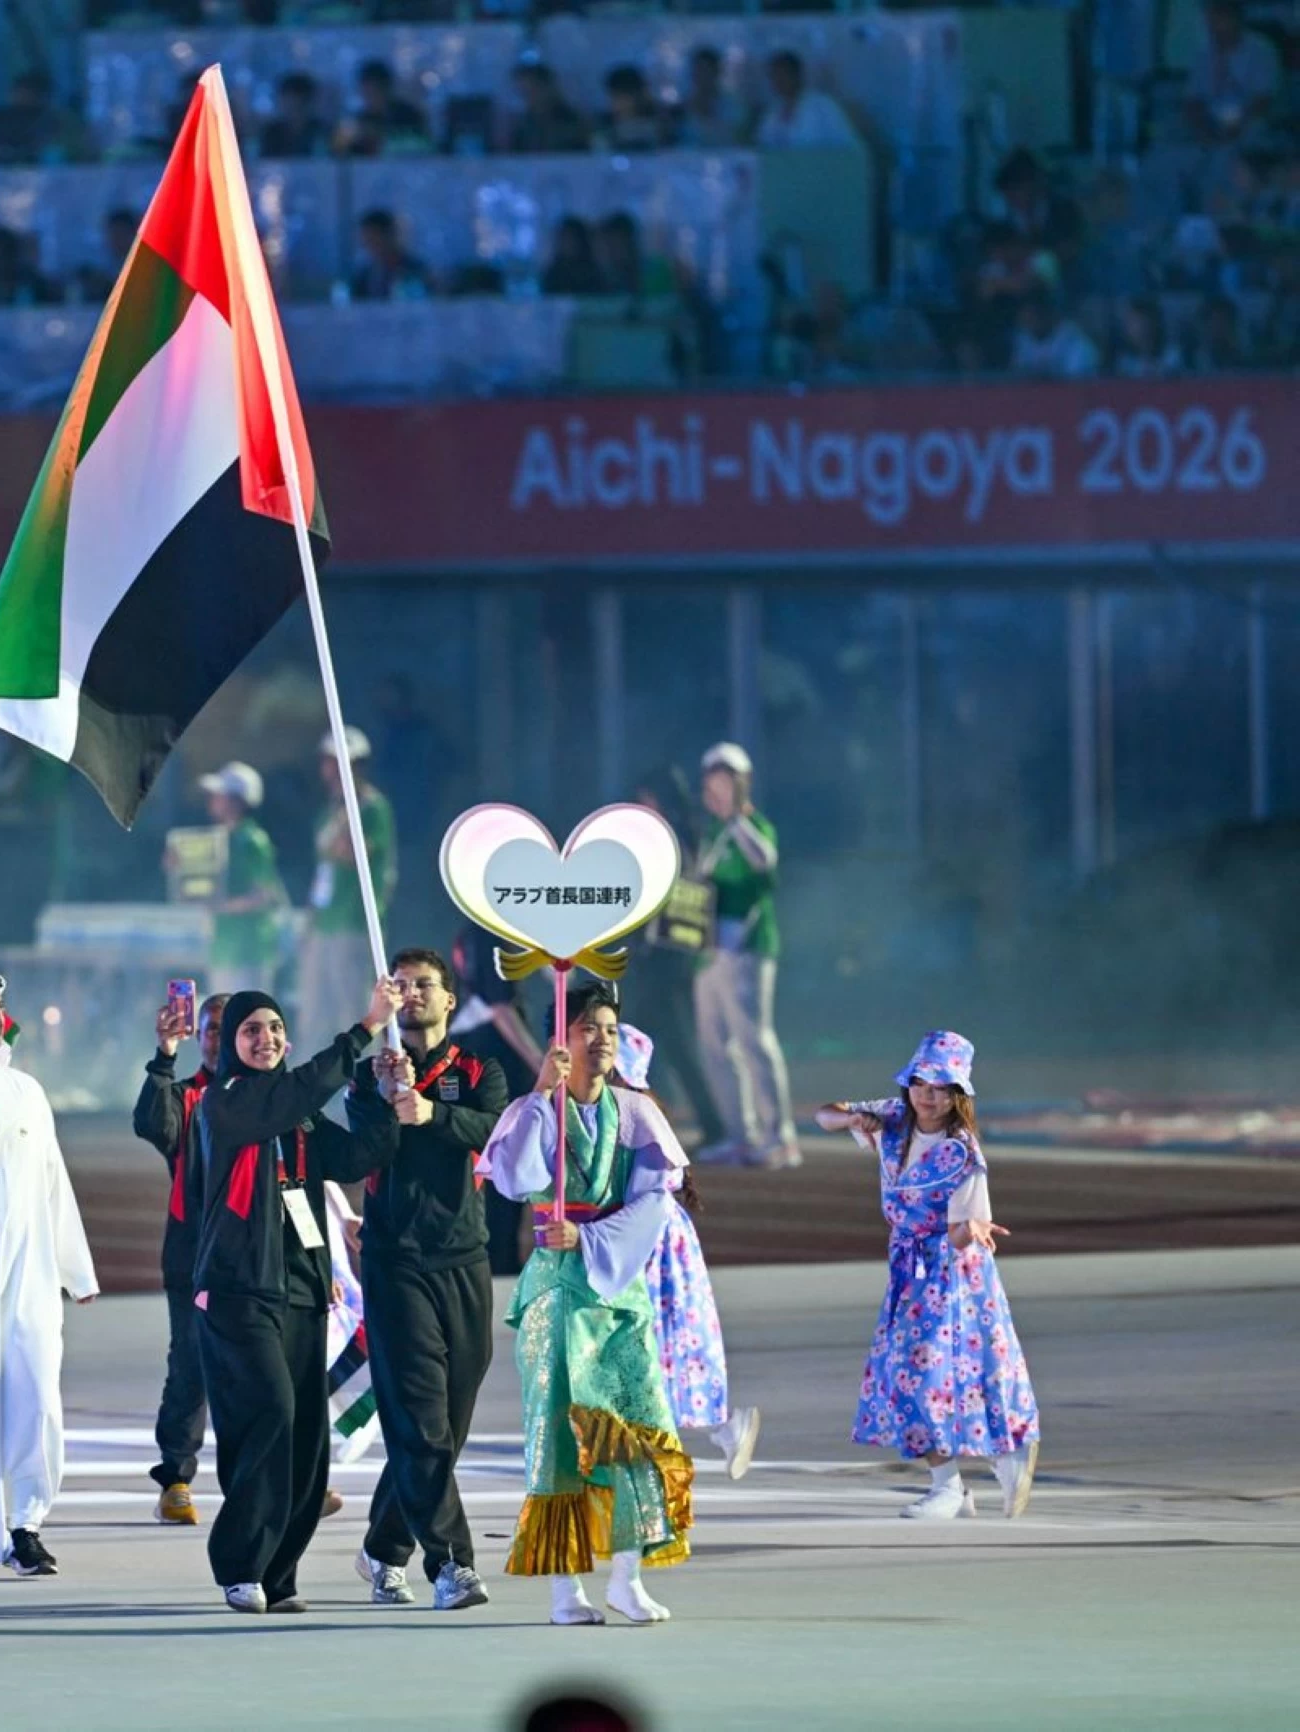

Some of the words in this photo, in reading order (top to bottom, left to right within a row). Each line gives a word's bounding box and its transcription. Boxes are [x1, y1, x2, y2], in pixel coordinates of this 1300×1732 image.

[511, 417, 1053, 525] Aichi-Nagoya
[1079, 407, 1266, 494] 2026
[493, 886, 631, 907] アラブ首長国連邦
